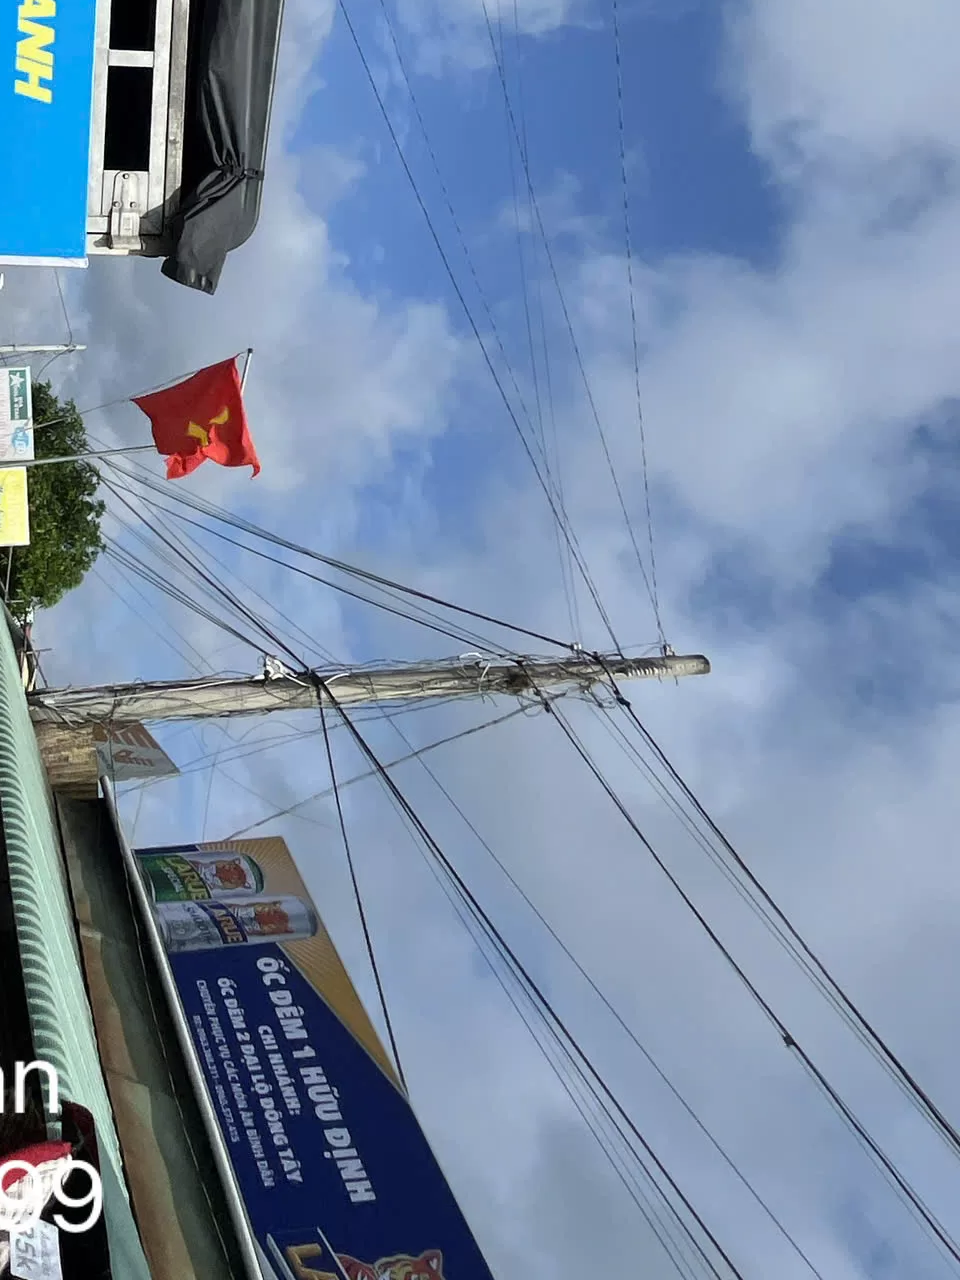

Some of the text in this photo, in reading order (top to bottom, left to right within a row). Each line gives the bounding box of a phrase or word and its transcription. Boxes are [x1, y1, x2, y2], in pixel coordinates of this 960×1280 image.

[165, 856, 209, 900] LARUE
[217, 977, 238, 996] ỐC
[235, 1032, 249, 1043] 2
[250, 1074, 272, 1095] LỘ
[278, 1148, 303, 1184] TÂY
[256, 957, 377, 1202] ỐC ĐÊM 1 HỮU ĐỊNH
[258, 1025, 302, 1116] CHI NHÁNH:
